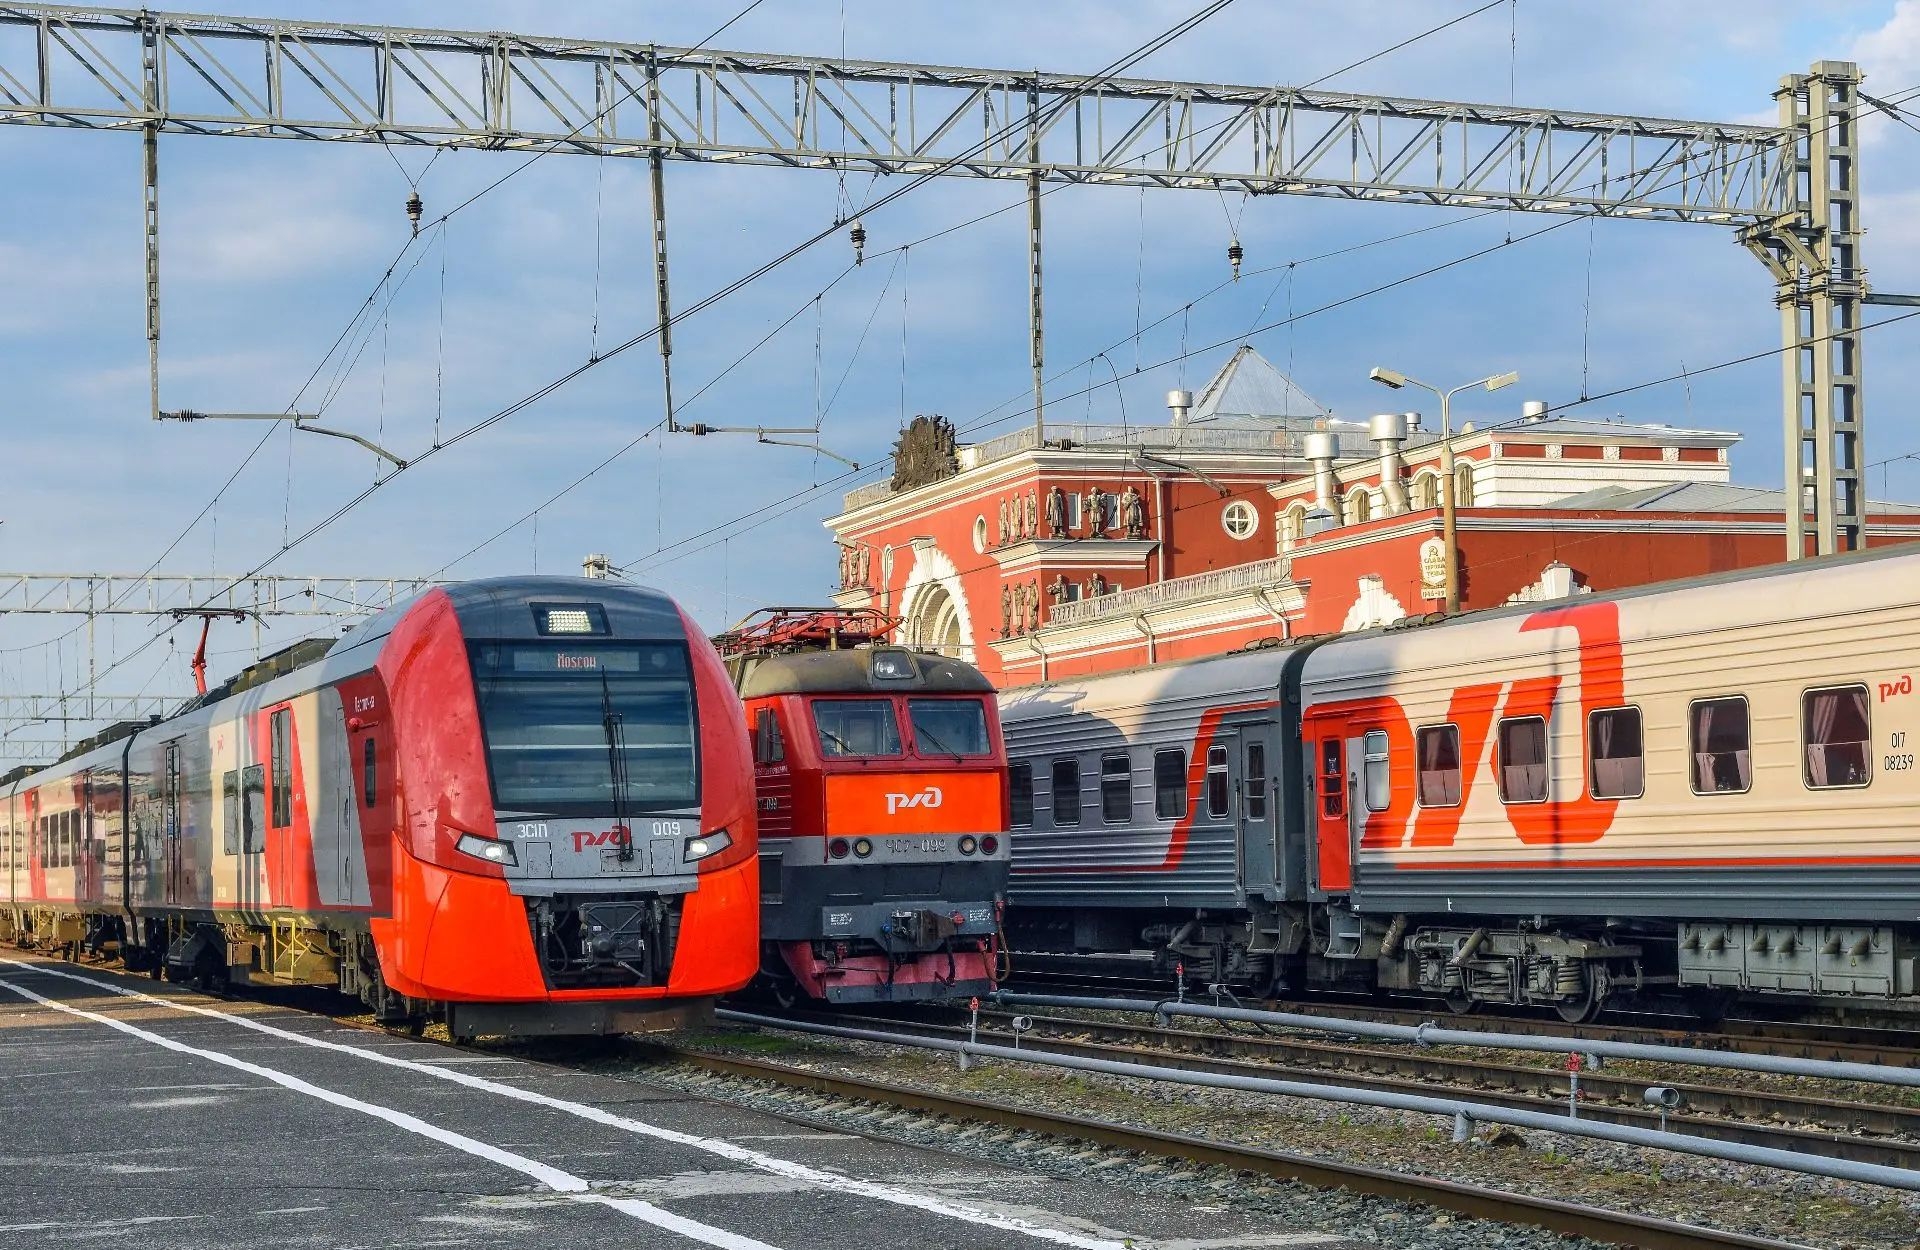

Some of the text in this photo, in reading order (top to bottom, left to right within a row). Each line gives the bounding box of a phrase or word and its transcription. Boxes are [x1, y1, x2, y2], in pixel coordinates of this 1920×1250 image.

[557, 653, 596, 668] Moscow
[1878, 675, 1912, 702] РЖД
[1891, 732, 1906, 748] 017
[1884, 755, 1914, 770] 08239
[885, 786, 943, 815] РЖД
[652, 821, 681, 835] 009
[571, 825, 632, 852] РЖД
